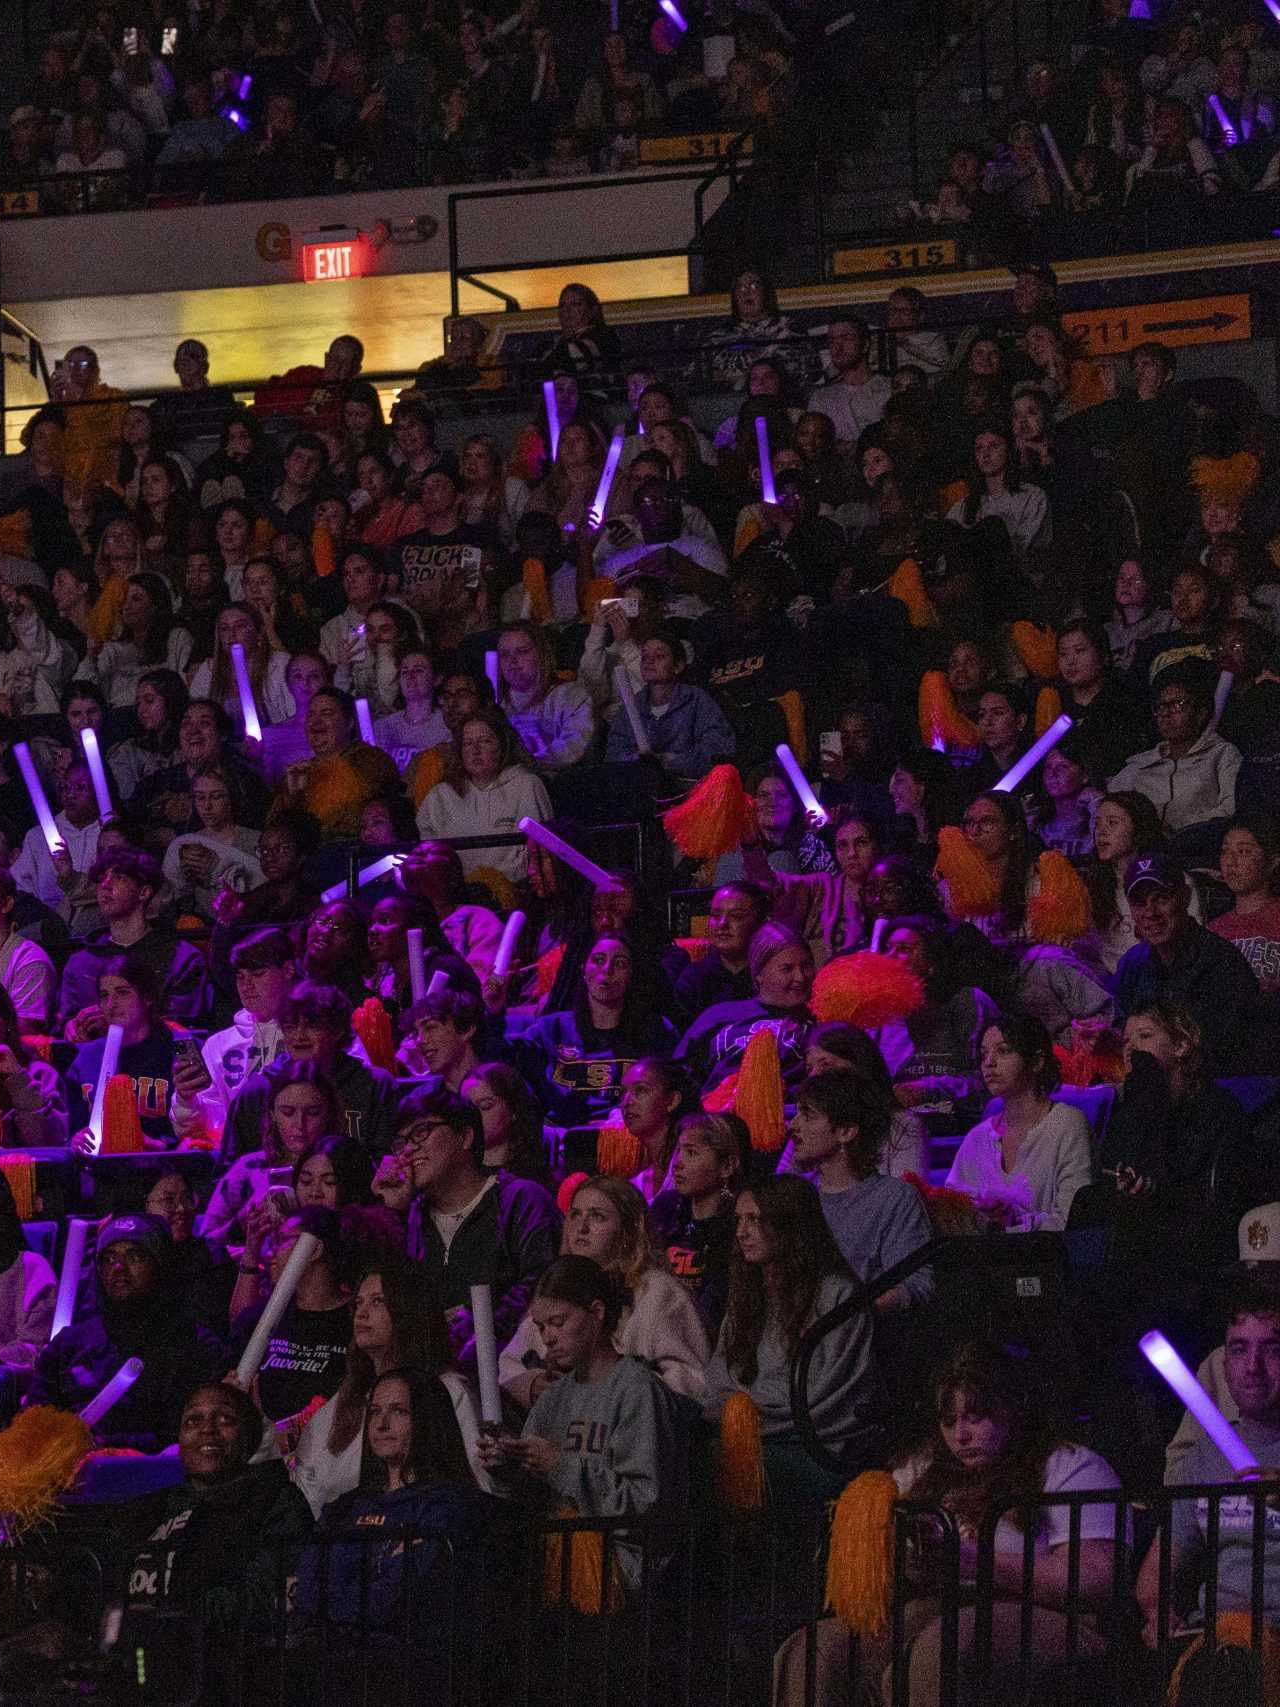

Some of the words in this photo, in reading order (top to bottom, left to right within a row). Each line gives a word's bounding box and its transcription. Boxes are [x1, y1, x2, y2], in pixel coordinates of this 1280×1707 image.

[314, 246, 352, 279] EXIT
[886, 245, 945, 269] 315
[260, 1353, 330, 1374] favorite!
